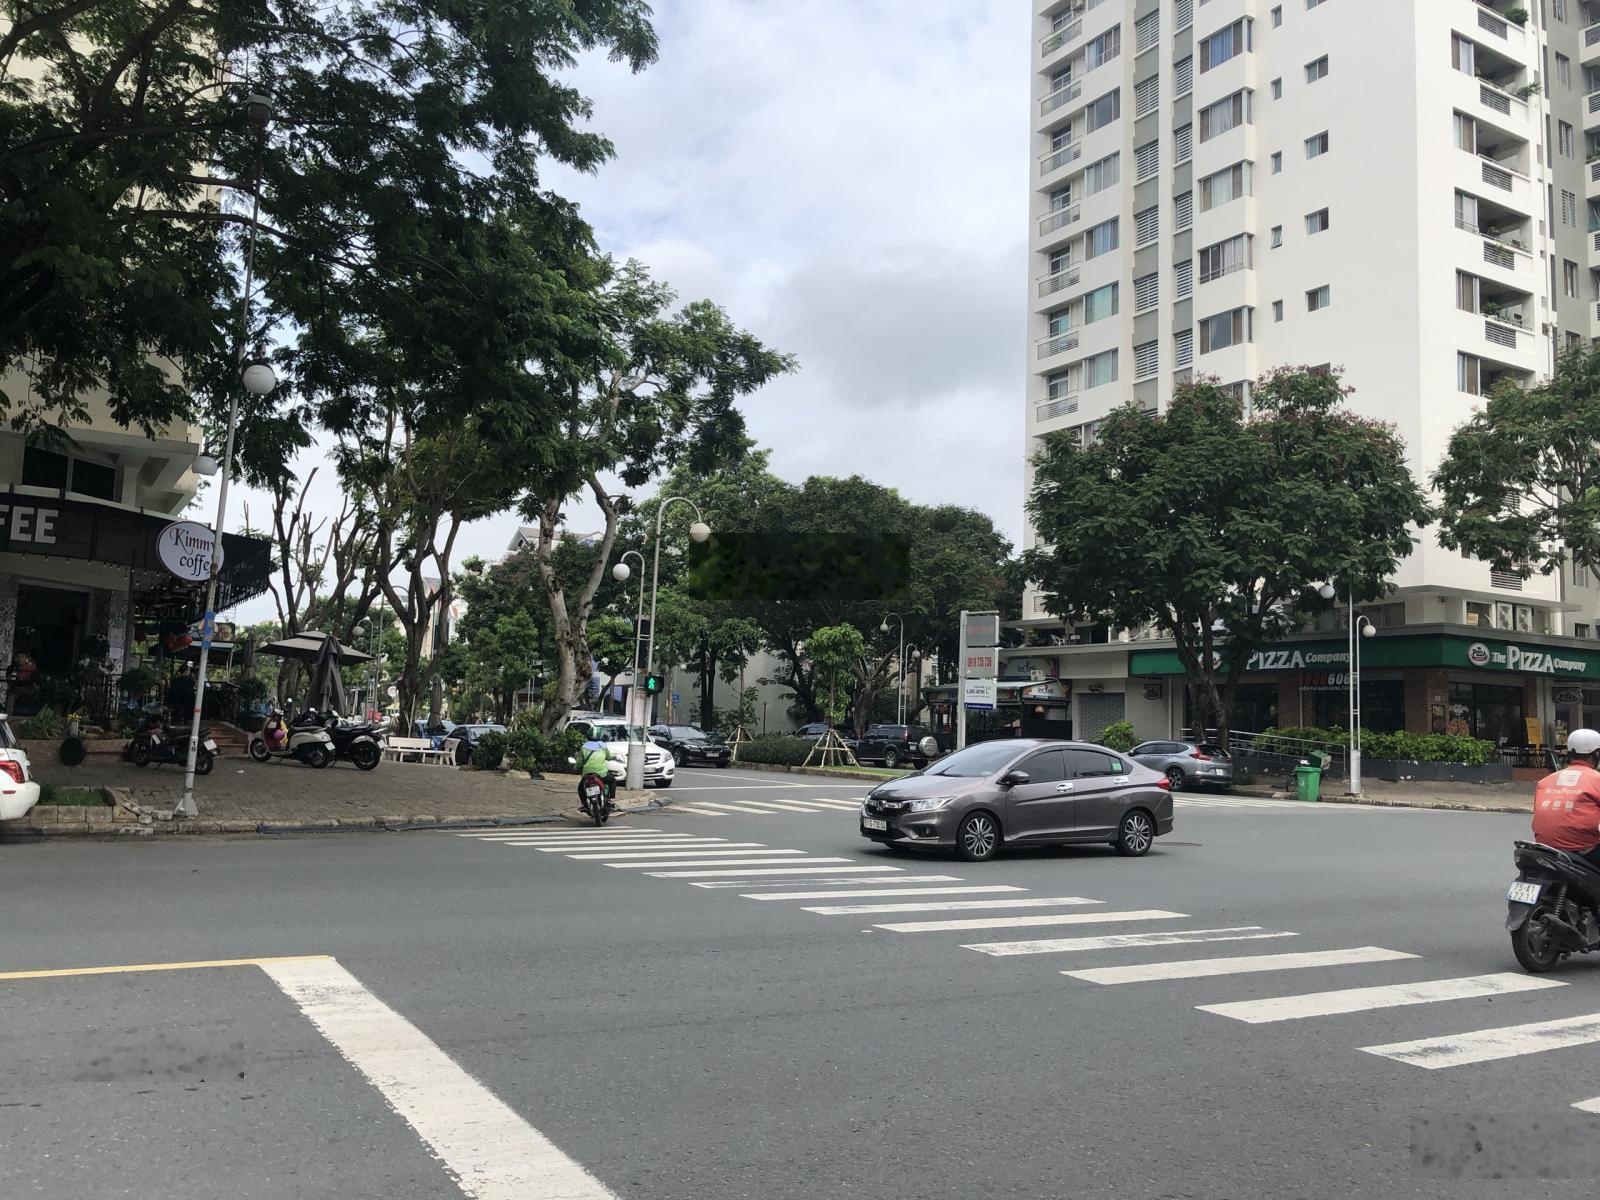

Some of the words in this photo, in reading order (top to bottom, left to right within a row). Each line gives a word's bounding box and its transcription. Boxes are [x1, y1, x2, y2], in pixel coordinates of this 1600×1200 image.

[170, 528, 214, 555] Kimm
[180, 554, 212, 576] coffe
[1305, 652, 1351, 665] Company
[1492, 652, 1506, 664] The
[1506, 646, 1554, 673] PIZZA
[1554, 658, 1587, 672] Company
